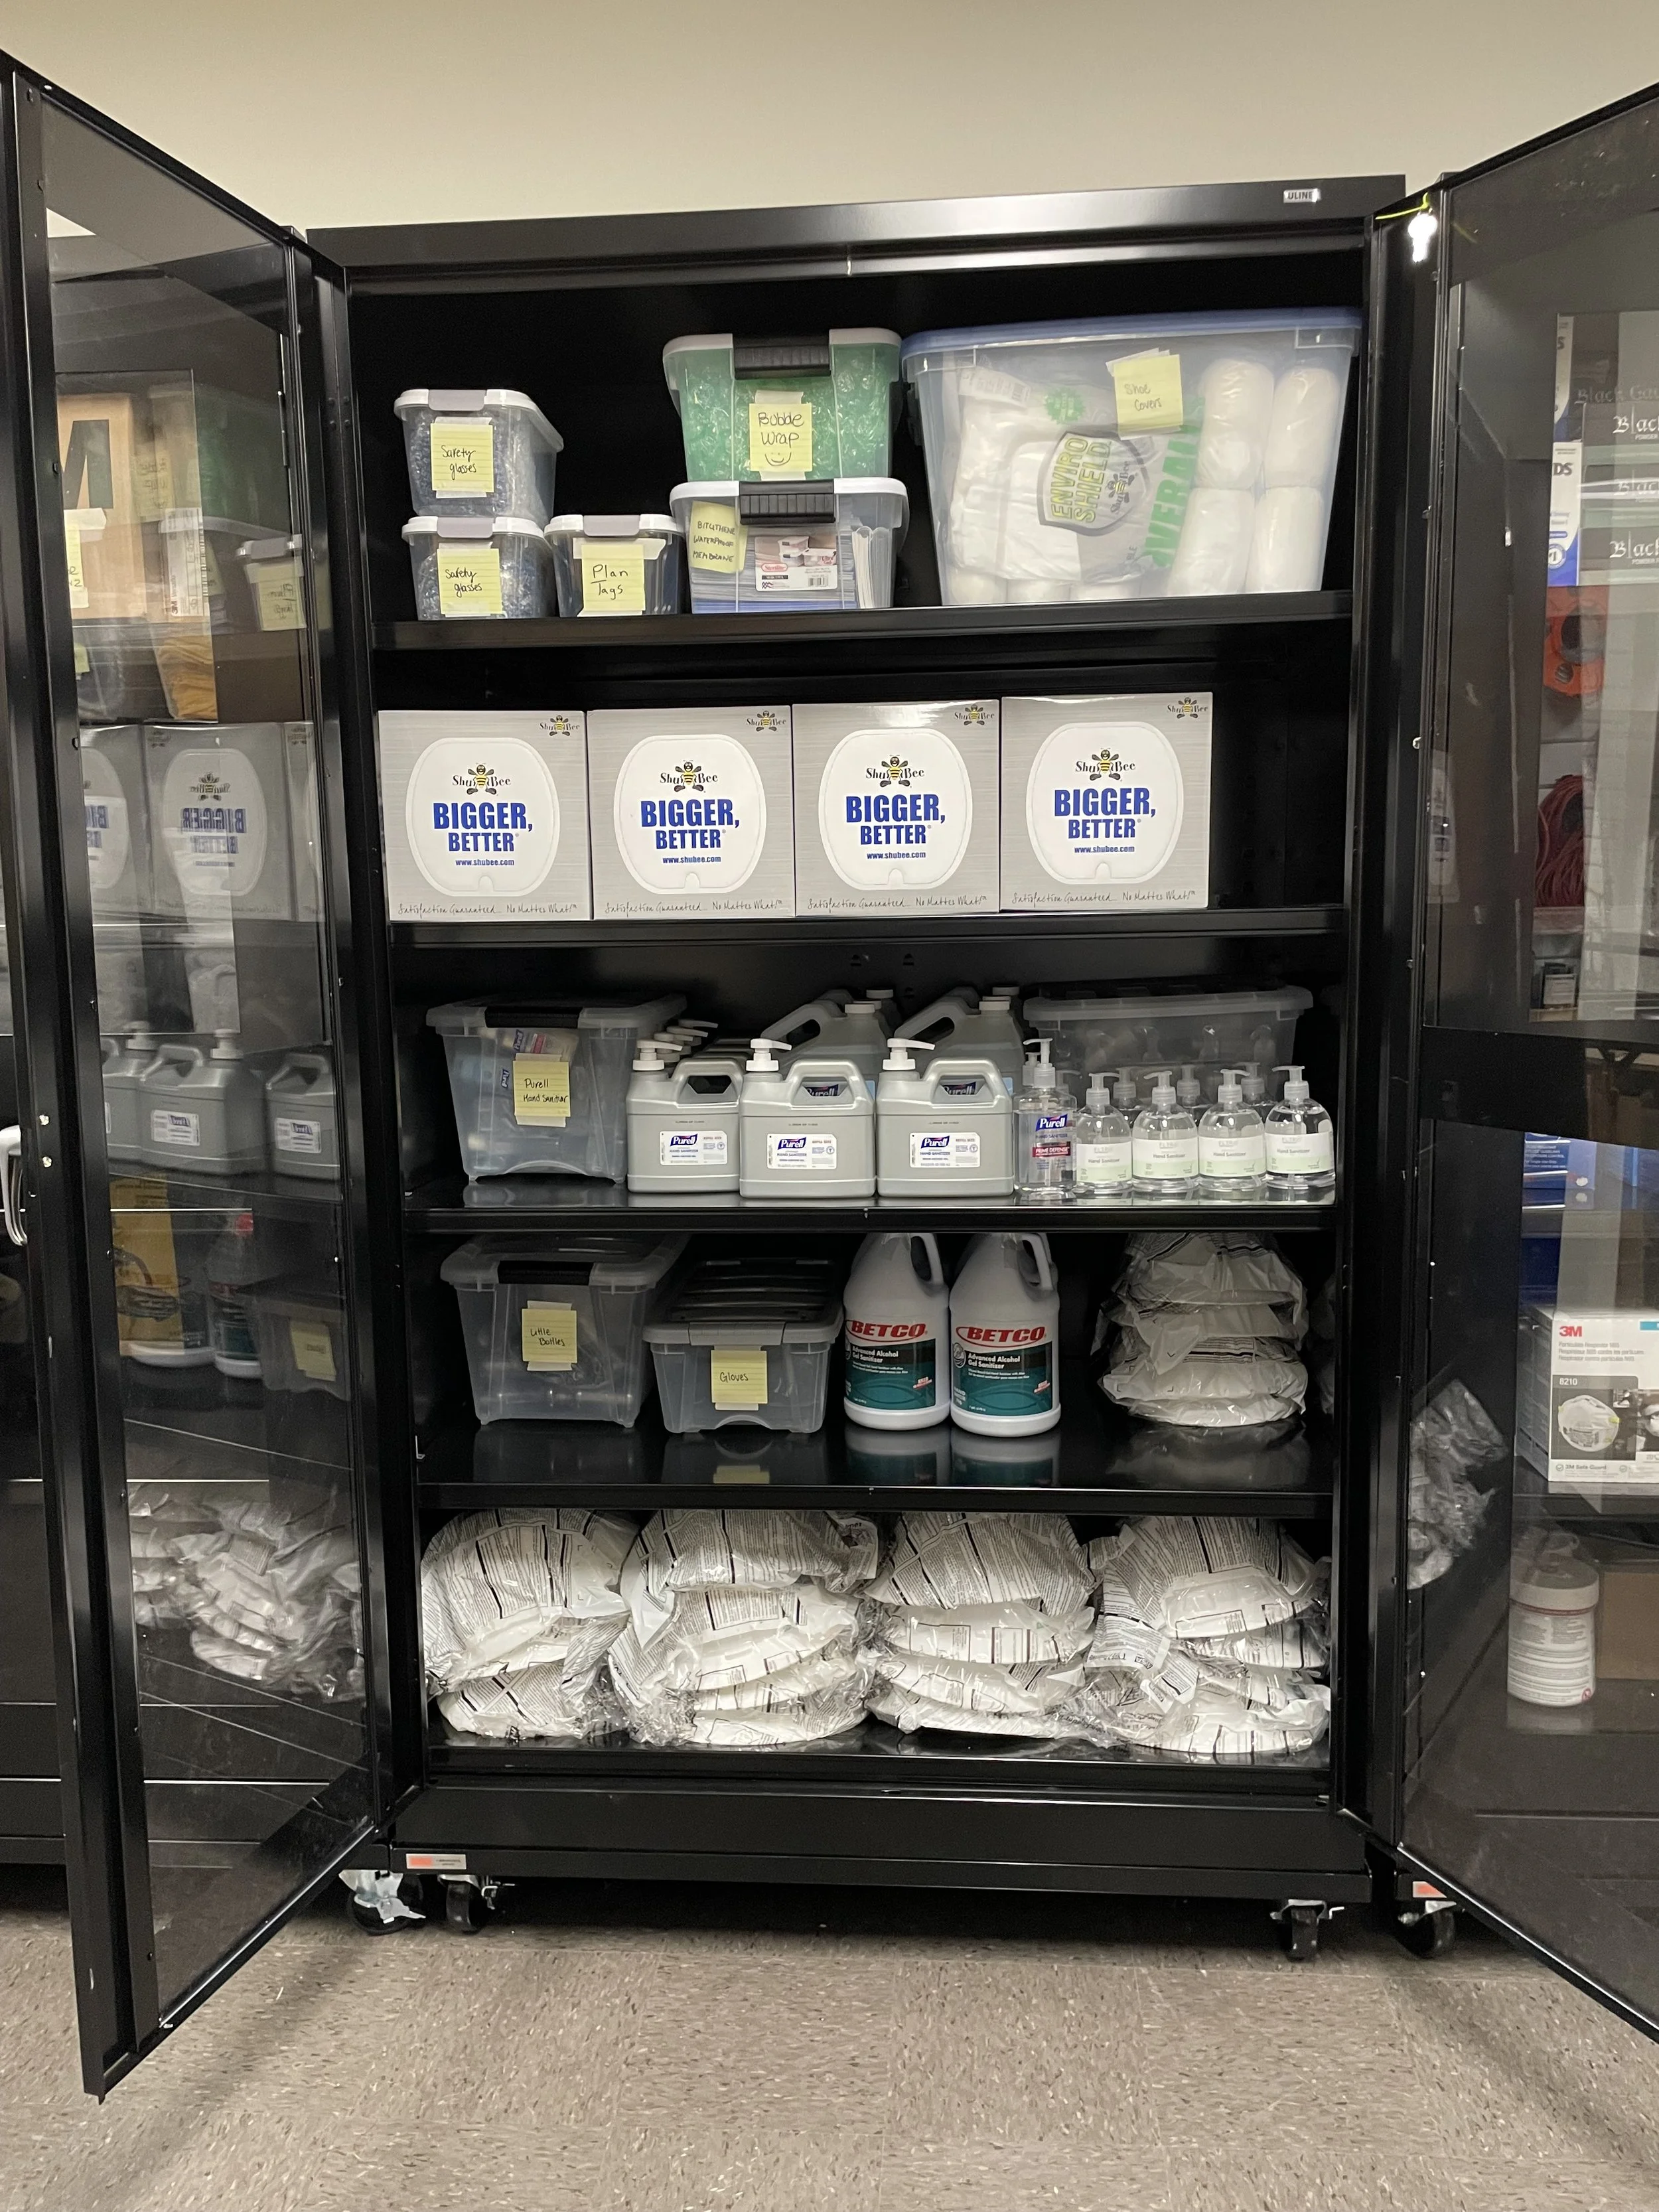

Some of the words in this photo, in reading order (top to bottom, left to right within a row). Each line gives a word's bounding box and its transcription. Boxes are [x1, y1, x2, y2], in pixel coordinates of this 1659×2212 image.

[1288, 191, 1313, 200] ULINE
[449, 463, 476, 480] glasses
[1050, 437, 1088, 520] ENVIRO
[1073, 441, 1111, 524] SHIELD
[445, 567, 477, 583] Safety
[593, 564, 628, 579] Plan
[454, 583, 482, 598] glasses
[591, 579, 623, 600] Tags
[865, 767, 890, 780] Shu
[902, 768, 925, 778] Bee
[1075, 761, 1100, 773] Shu
[1112, 762, 1136, 772] Bee
[452, 774, 476, 786] Shu
[488, 777, 512, 786] Bee
[660, 773, 684, 784] Shu
[695, 773, 718, 784] Bee
[846, 794, 946, 824] BIGGER,
[1054, 787, 1156, 818] BIGGER,
[433, 802, 533, 832] BIGGER,
[640, 799, 740, 828] BIGGER,
[860, 825, 926, 845] BETTER
[1068, 818, 1135, 839] BETTER
[449, 832, 515, 851] BETTER
[656, 829, 721, 849] BETTER
[1074, 845, 1135, 853] www.shubee.com
[808, 899, 856, 913] Satisfaction
[916, 897, 925, 906] No
[927, 896, 956, 906] Matter
[1012, 892, 1062, 907] Satisfaction
[1123, 892, 1131, 901] No
[1135, 891, 1162, 900] Matter
[398, 903, 447, 919] Satisfaction
[507, 905, 516, 913] No
[518, 905, 546, 914] Matter
[605, 902, 654, 918] Satisfaction
[713, 901, 721, 911] No
[723, 901, 751, 910] Matter
[524, 1078, 548, 1089] Purell
[1039, 1118, 1065, 1128] Purell
[672, 1136, 696, 1145] Purell
[780, 1140, 804, 1148] Purell
[924, 1138, 948, 1147] Purell
[851, 1320, 926, 1338] BETCO
[967, 1327, 1045, 1342] BETCO
[1559, 1326, 1582, 1337] 3M
[538, 1337, 565, 1347] Bottles
[968, 1353, 995, 1363] Advanced
[719, 1372, 749, 1383] Gloves
